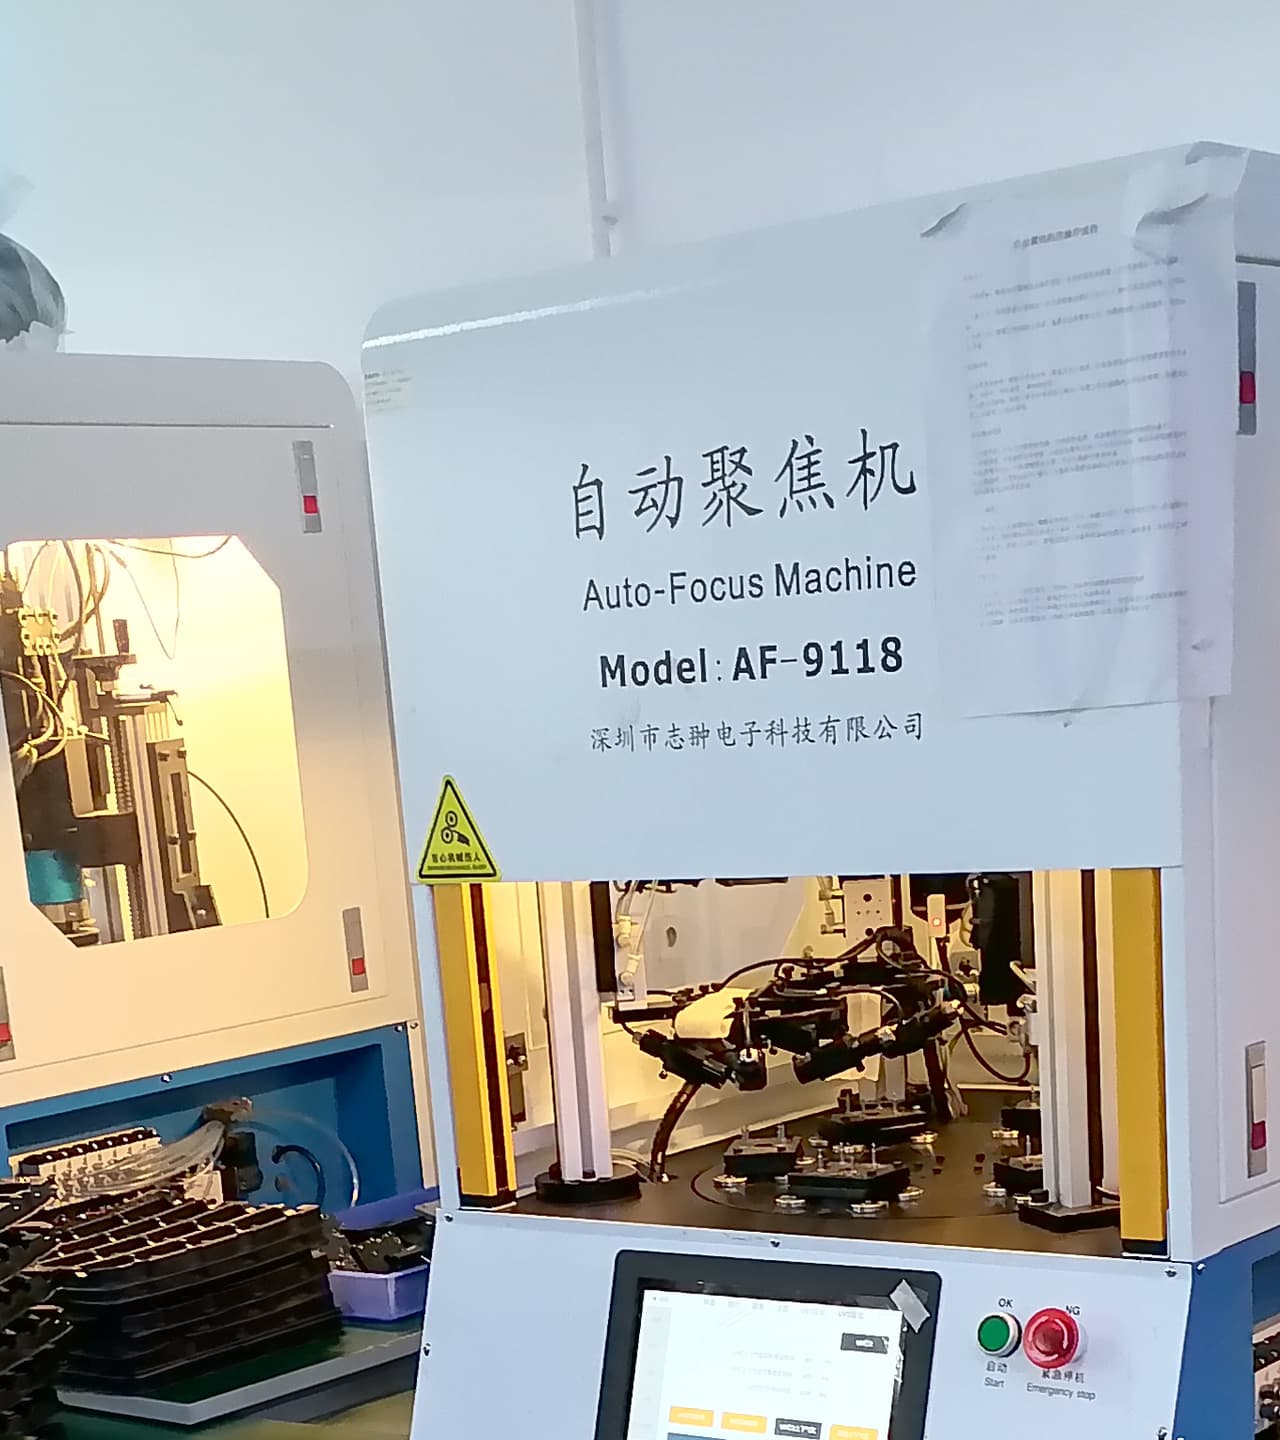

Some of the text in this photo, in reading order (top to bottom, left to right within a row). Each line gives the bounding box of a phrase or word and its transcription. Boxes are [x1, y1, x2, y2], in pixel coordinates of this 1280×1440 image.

[571, 428, 917, 541] 自动聚焦机
[583, 555, 917, 612] Auto-Focus Machine
[998, 1298, 1014, 1308] OK
[1065, 1305, 1081, 1316] NG
[984, 1377, 1005, 1388] Start
[1026, 1382, 1074, 1399] Emergency
